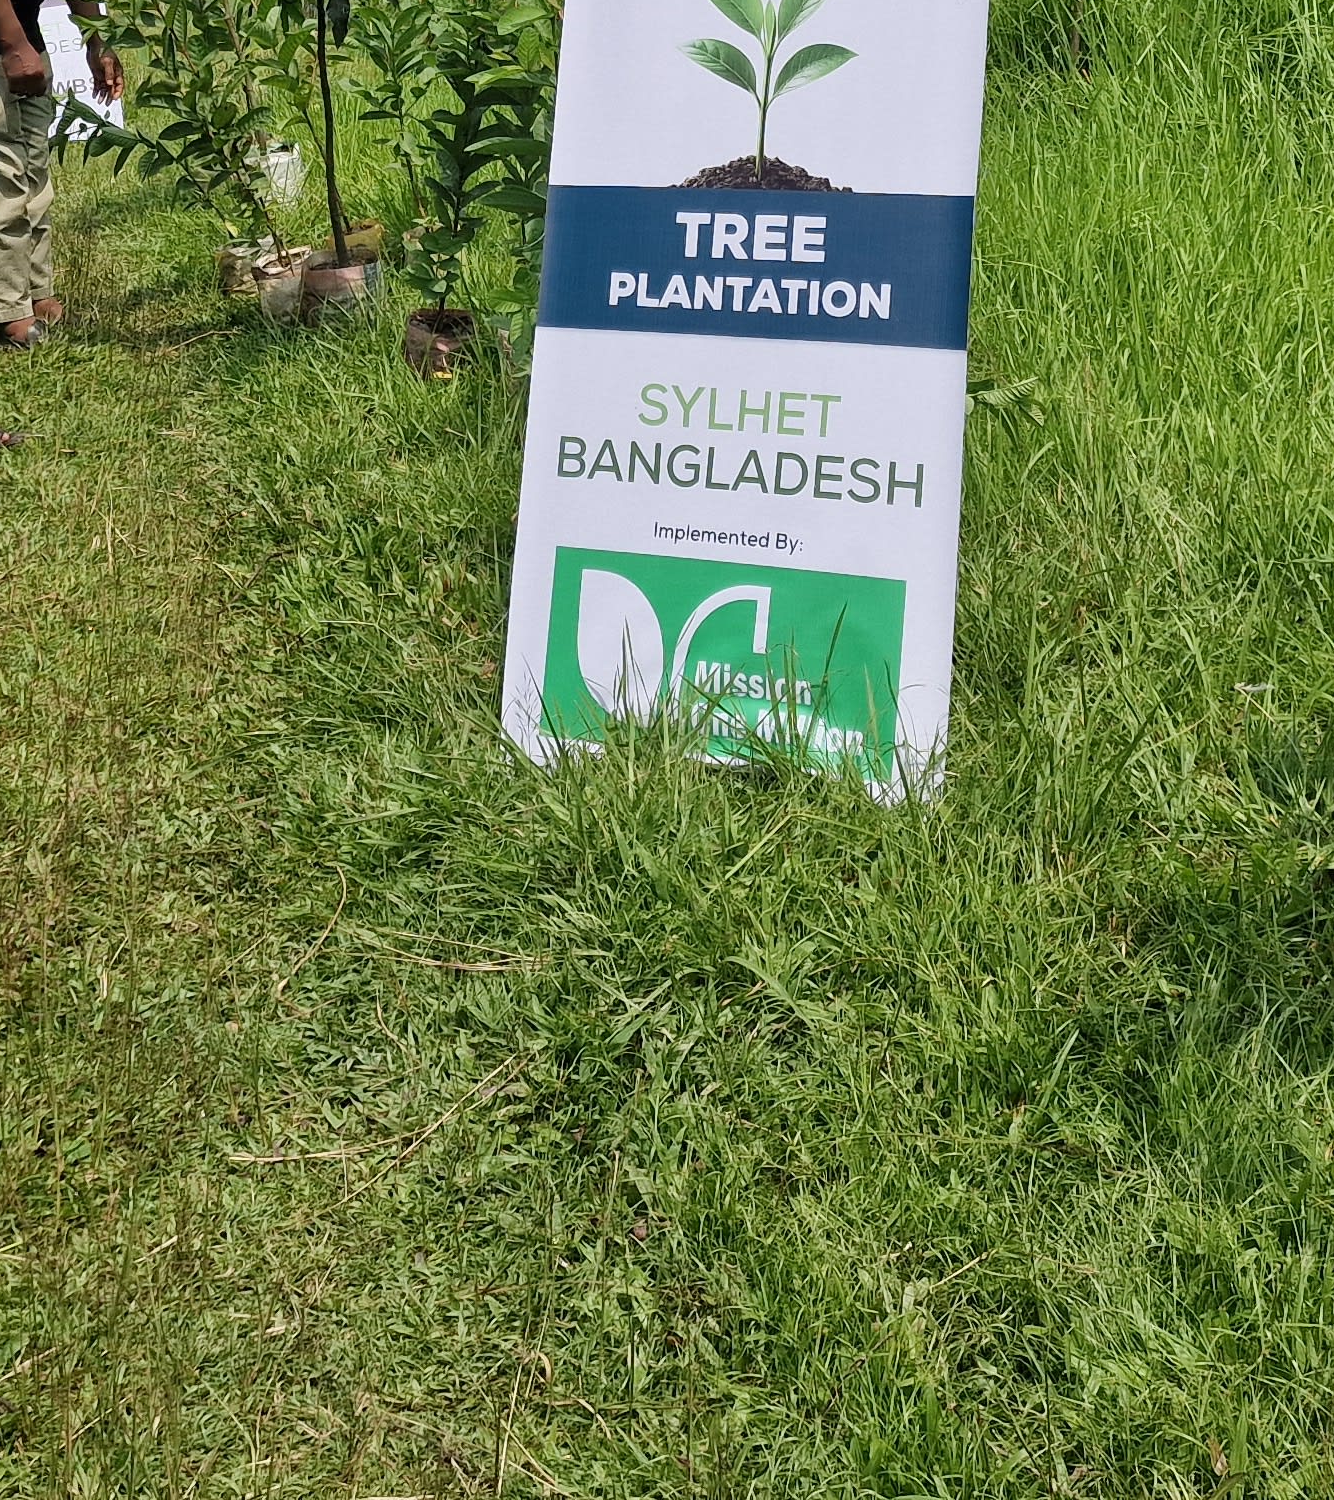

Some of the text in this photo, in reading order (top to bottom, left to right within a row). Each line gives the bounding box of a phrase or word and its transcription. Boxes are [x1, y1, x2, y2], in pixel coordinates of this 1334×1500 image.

[675, 211, 827, 263] TREE
[608, 272, 892, 320] PLANTATION
[638, 383, 842, 438] SYLHET
[557, 435, 925, 508] BANGLADESH
[654, 521, 804, 556] Implemented By:
